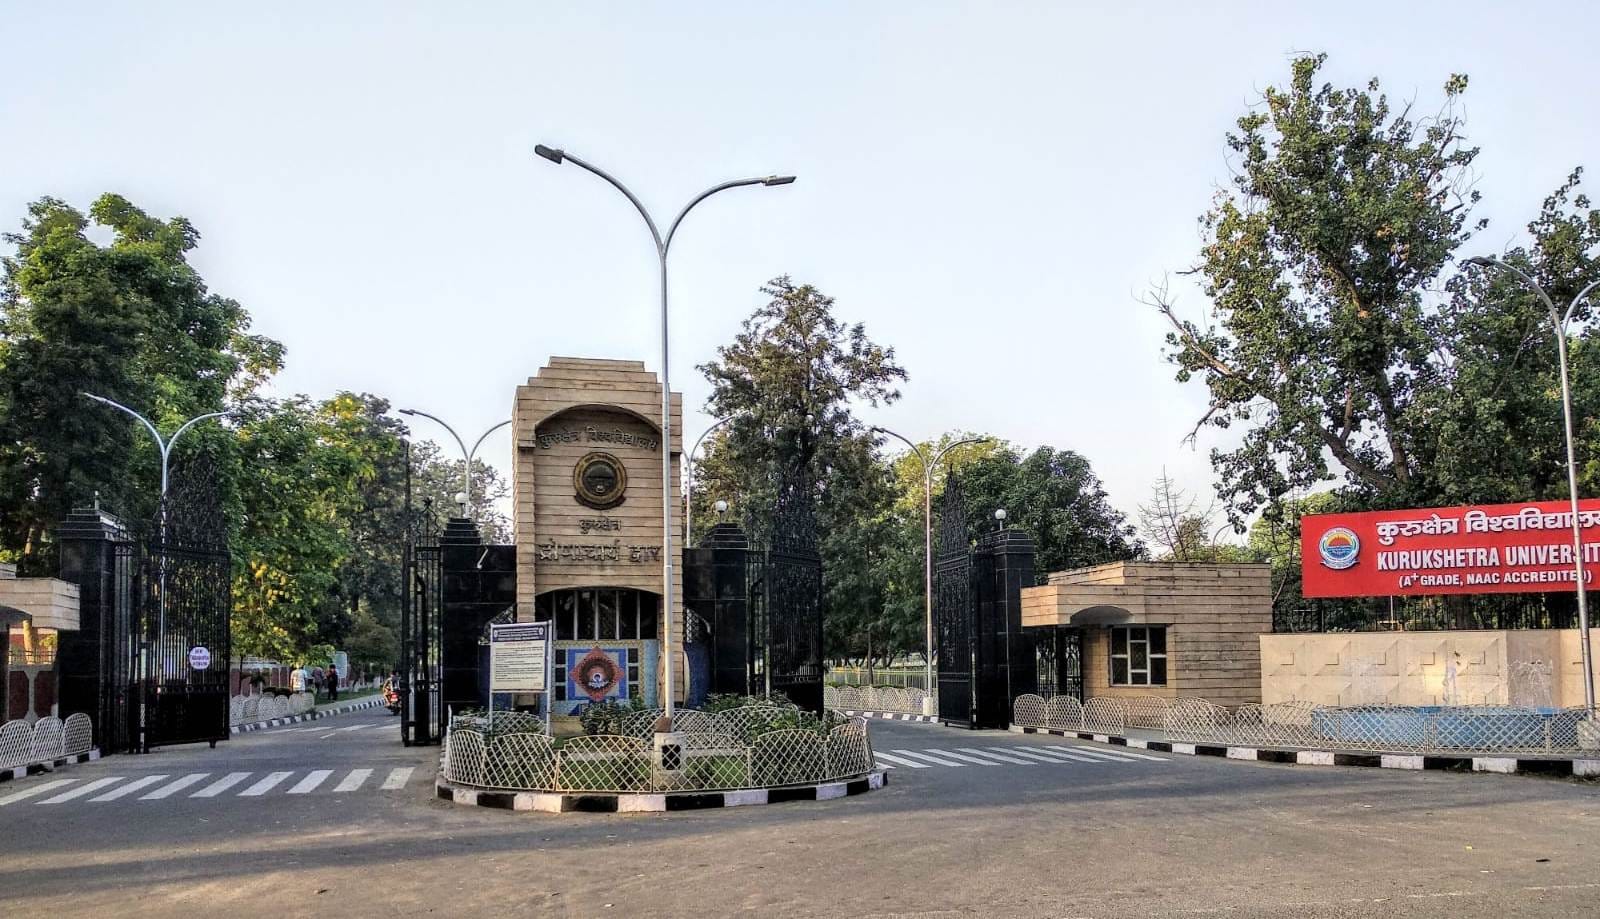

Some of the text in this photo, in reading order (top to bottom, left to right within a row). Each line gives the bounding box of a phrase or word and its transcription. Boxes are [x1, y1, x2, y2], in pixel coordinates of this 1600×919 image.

[1376, 513, 1460, 545] कुरुक्षेत्र
[1377, 547, 1500, 571] KURUKSHETRA
[1467, 572, 1500, 585] NAAC
[1504, 570, 1592, 584] ACCREDITE)
